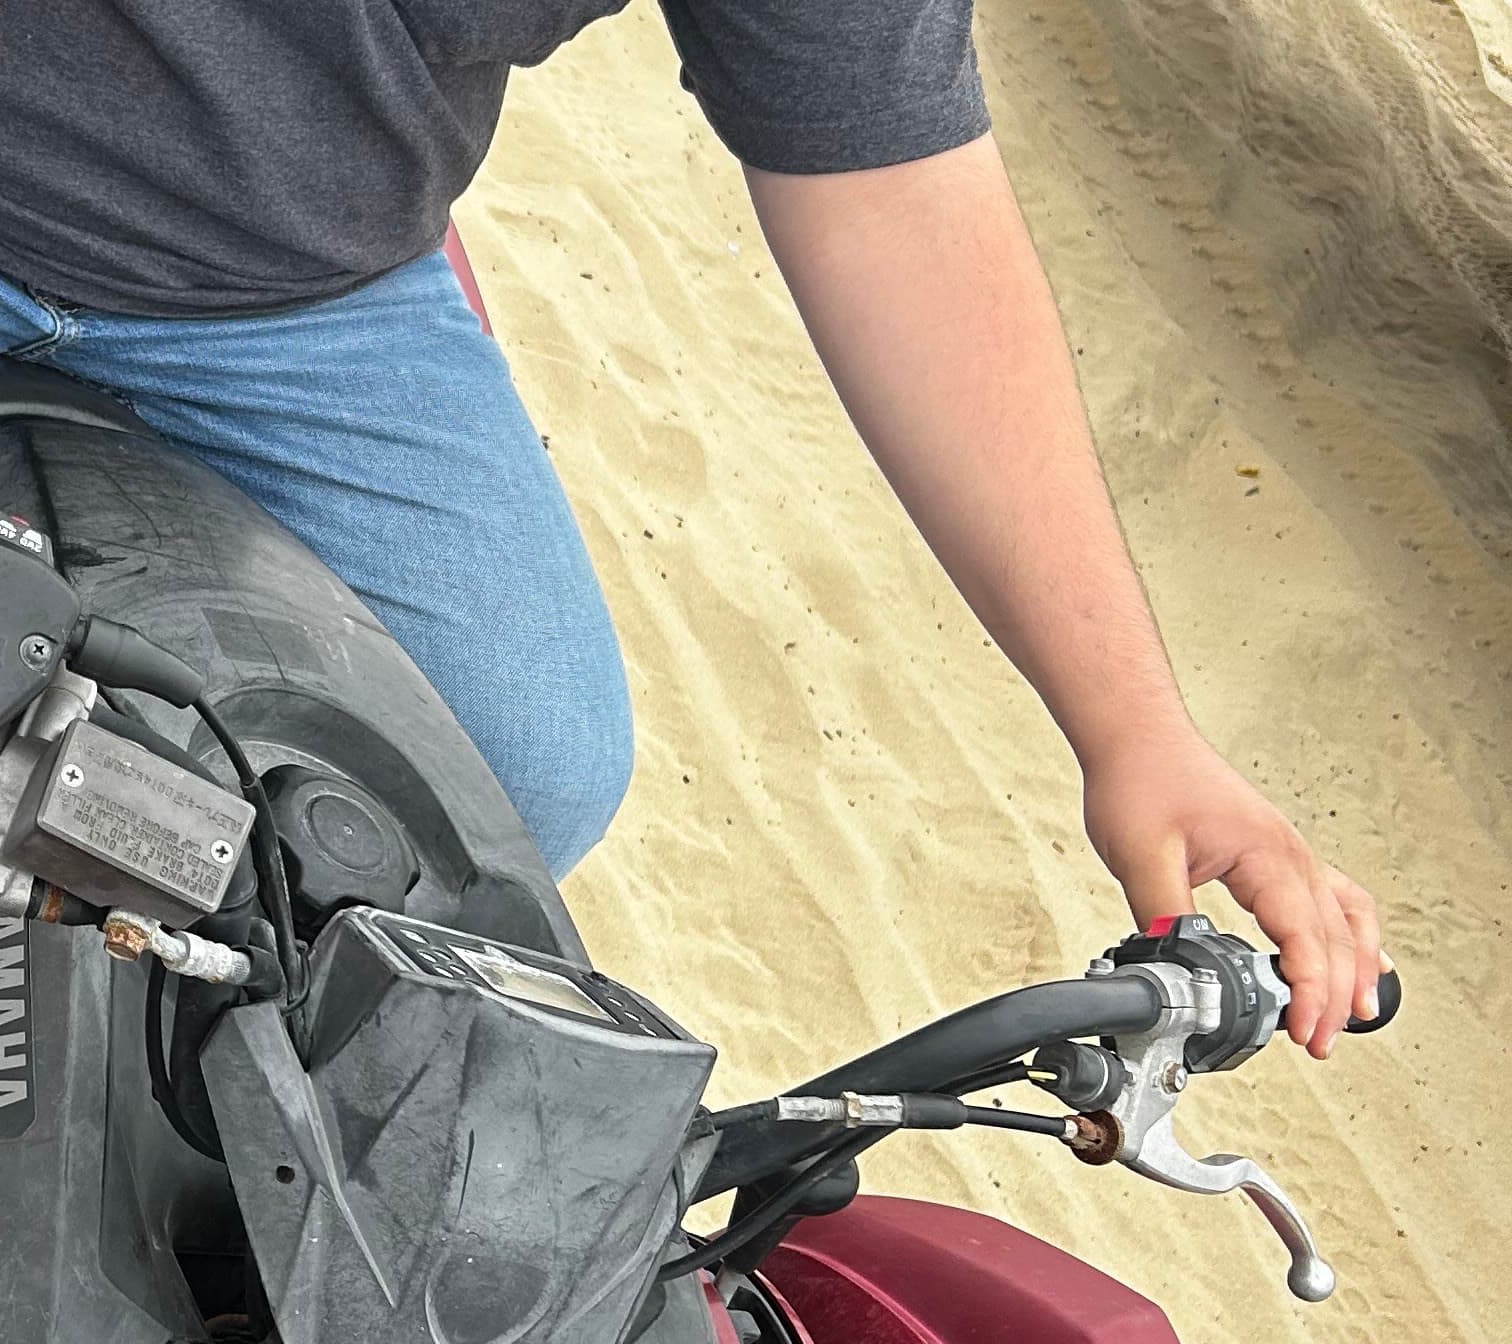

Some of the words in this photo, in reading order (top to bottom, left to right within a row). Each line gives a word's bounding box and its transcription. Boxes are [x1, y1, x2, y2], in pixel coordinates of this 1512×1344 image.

[73, 809, 106, 833] FROM
[140, 815, 180, 842] BEFORE
[88, 831, 118, 852] ONLY
[180, 838, 202, 855] CAP
[125, 847, 148, 868] USE
[149, 847, 184, 872] BRAKE
